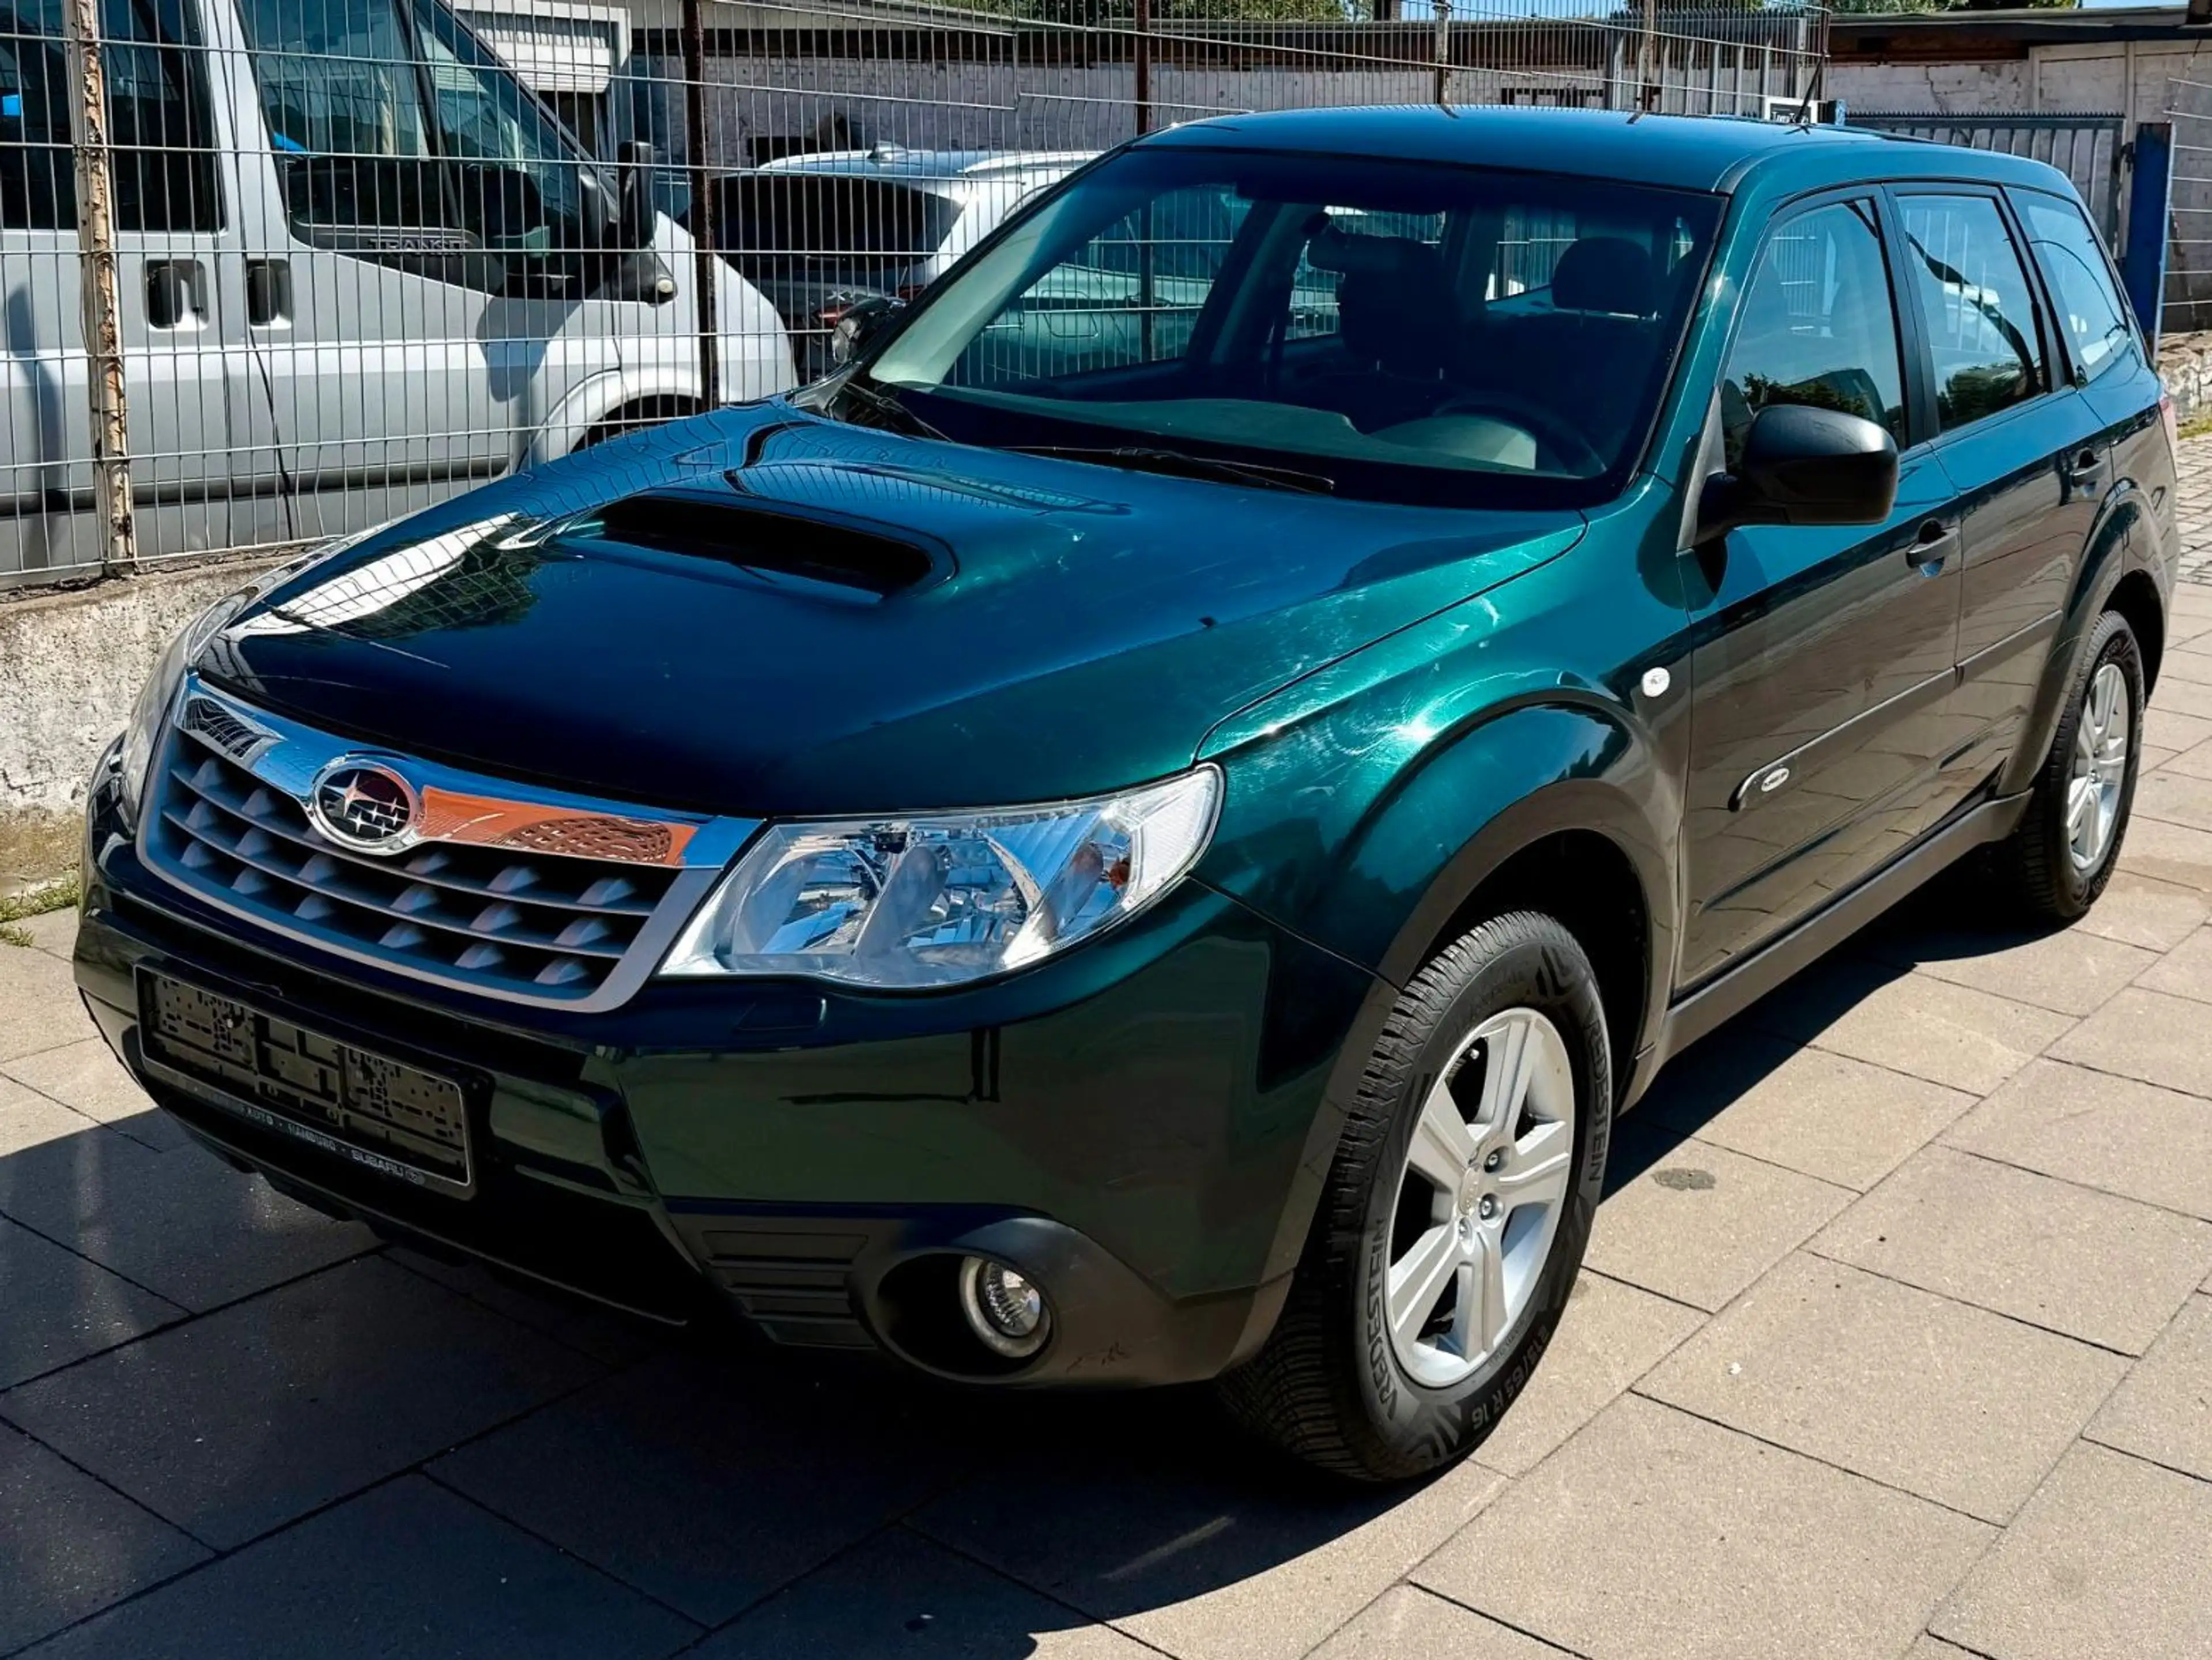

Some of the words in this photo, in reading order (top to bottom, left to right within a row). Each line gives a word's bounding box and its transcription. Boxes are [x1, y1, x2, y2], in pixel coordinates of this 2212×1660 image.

[1583, 1003, 1610, 1182] VREDESTEIN
[1367, 1218, 1398, 1421] VREDESTEIN
[1471, 1402, 1490, 1431] 16
